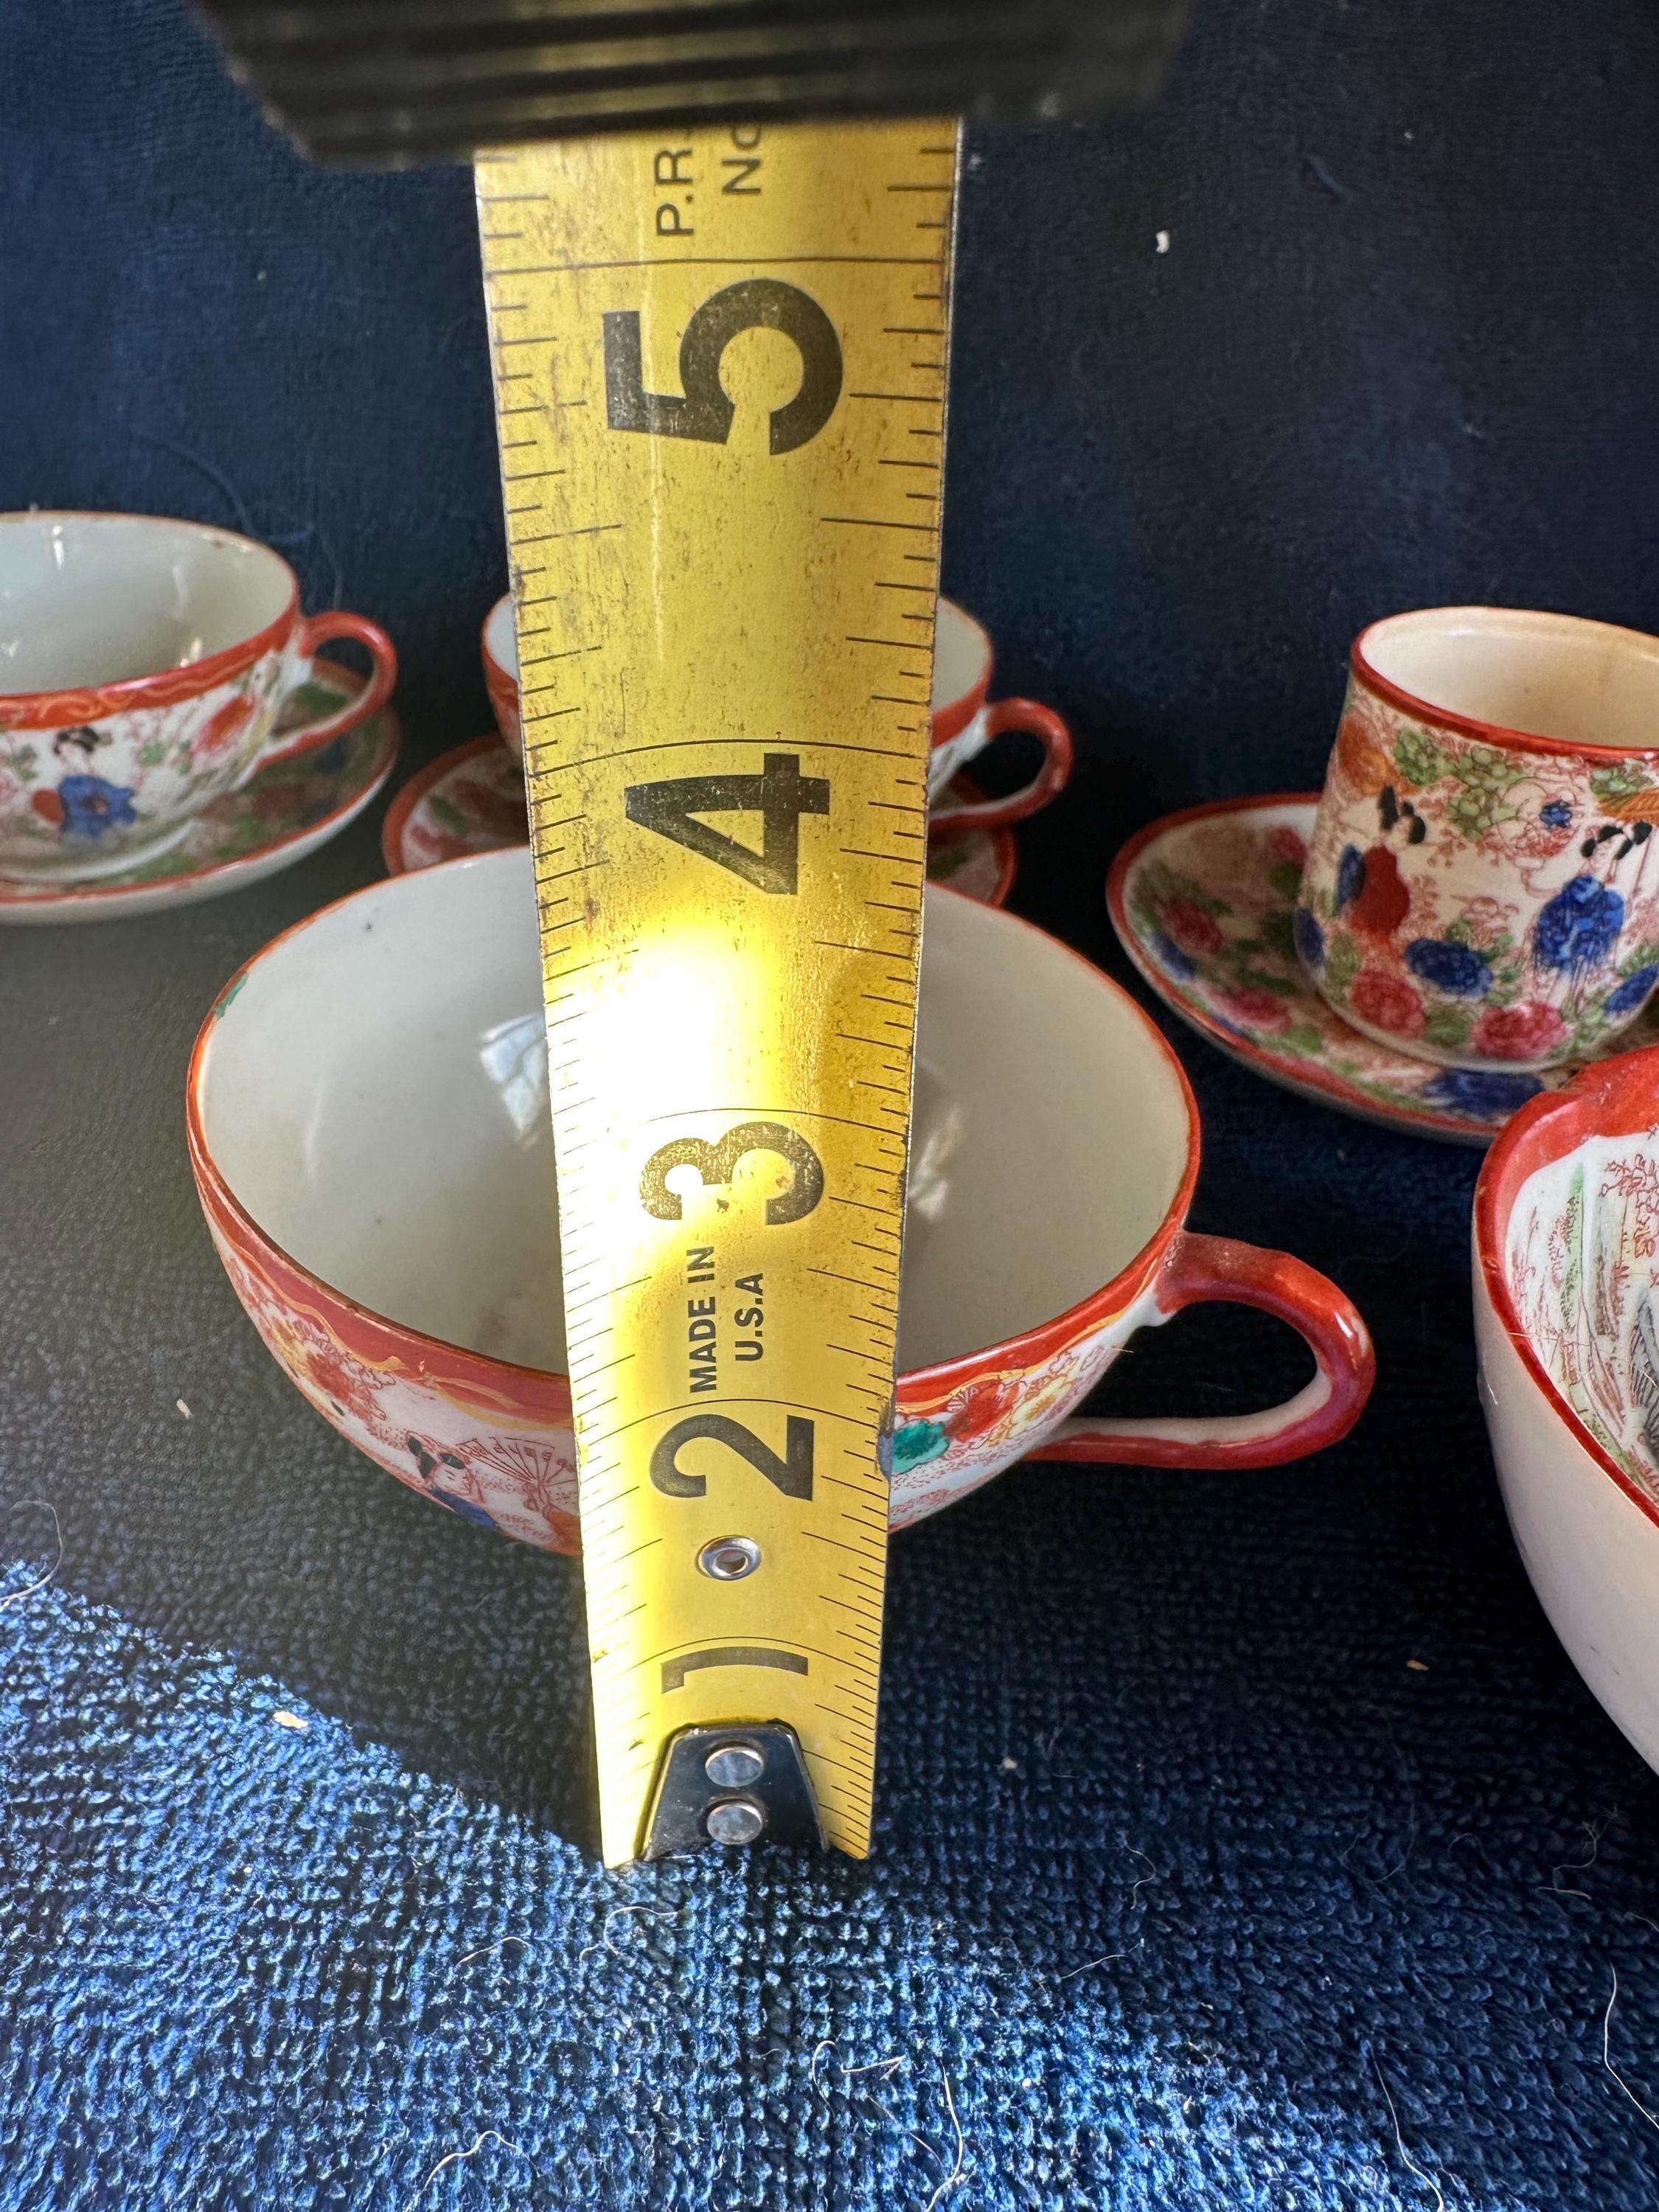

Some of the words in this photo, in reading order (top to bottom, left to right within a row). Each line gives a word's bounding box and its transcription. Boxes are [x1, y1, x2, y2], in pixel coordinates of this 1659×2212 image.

[602, 277, 844, 456] 5
[624, 752, 830, 895] 4
[639, 1121, 824, 1225] 3
[686, 1245, 715, 1284] IN
[687, 1296, 717, 1394] MADE
[734, 1273, 765, 1361] U.S.A
[649, 1413, 815, 1501] 2
[661, 1646, 809, 1694] 1
